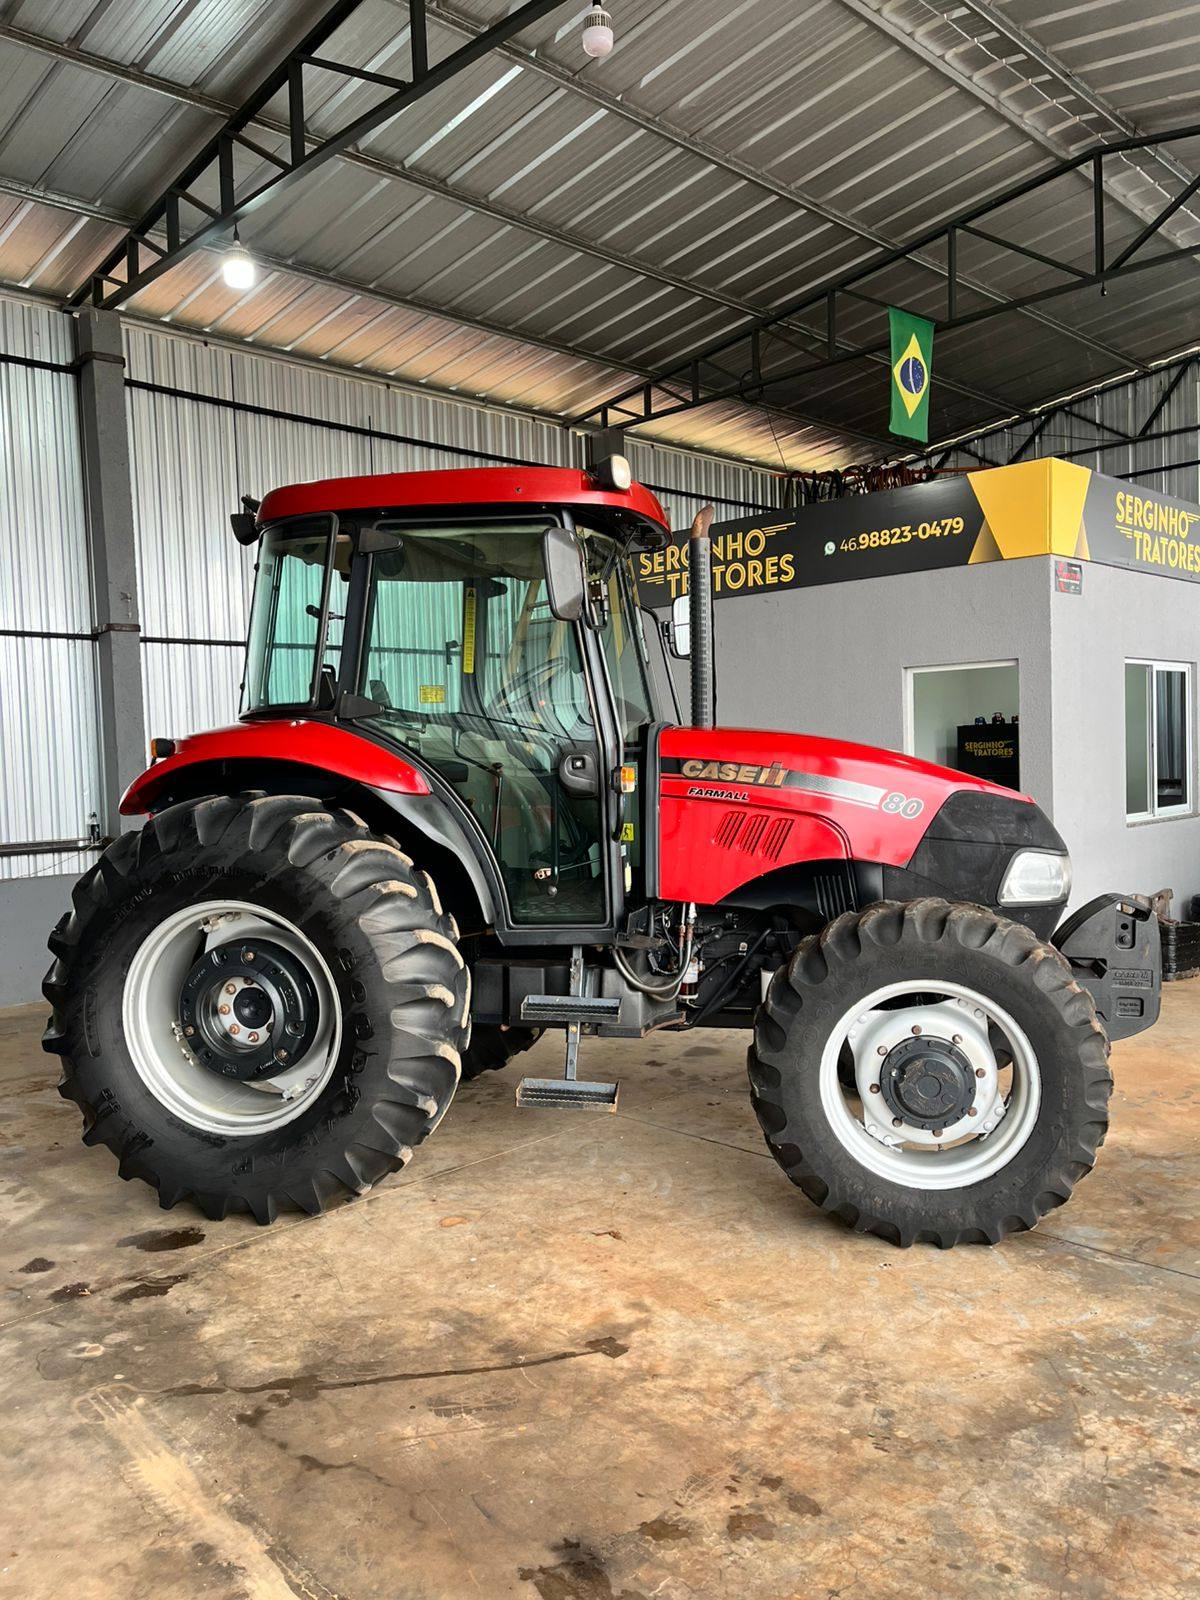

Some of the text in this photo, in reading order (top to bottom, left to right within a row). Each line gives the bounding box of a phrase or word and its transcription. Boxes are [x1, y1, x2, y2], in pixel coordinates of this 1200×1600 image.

[1115, 491, 1189, 539] SERGINHO
[839, 516, 965, 553] 46.98823-0479
[1133, 530, 1200, 573] TRATORES
[666, 553, 796, 598] TRTORES
[974, 748, 1014, 757] TRATORES
[682, 760, 760, 783] CASE
[688, 787, 750, 801] FARMALL
[881, 791, 925, 820] 80
